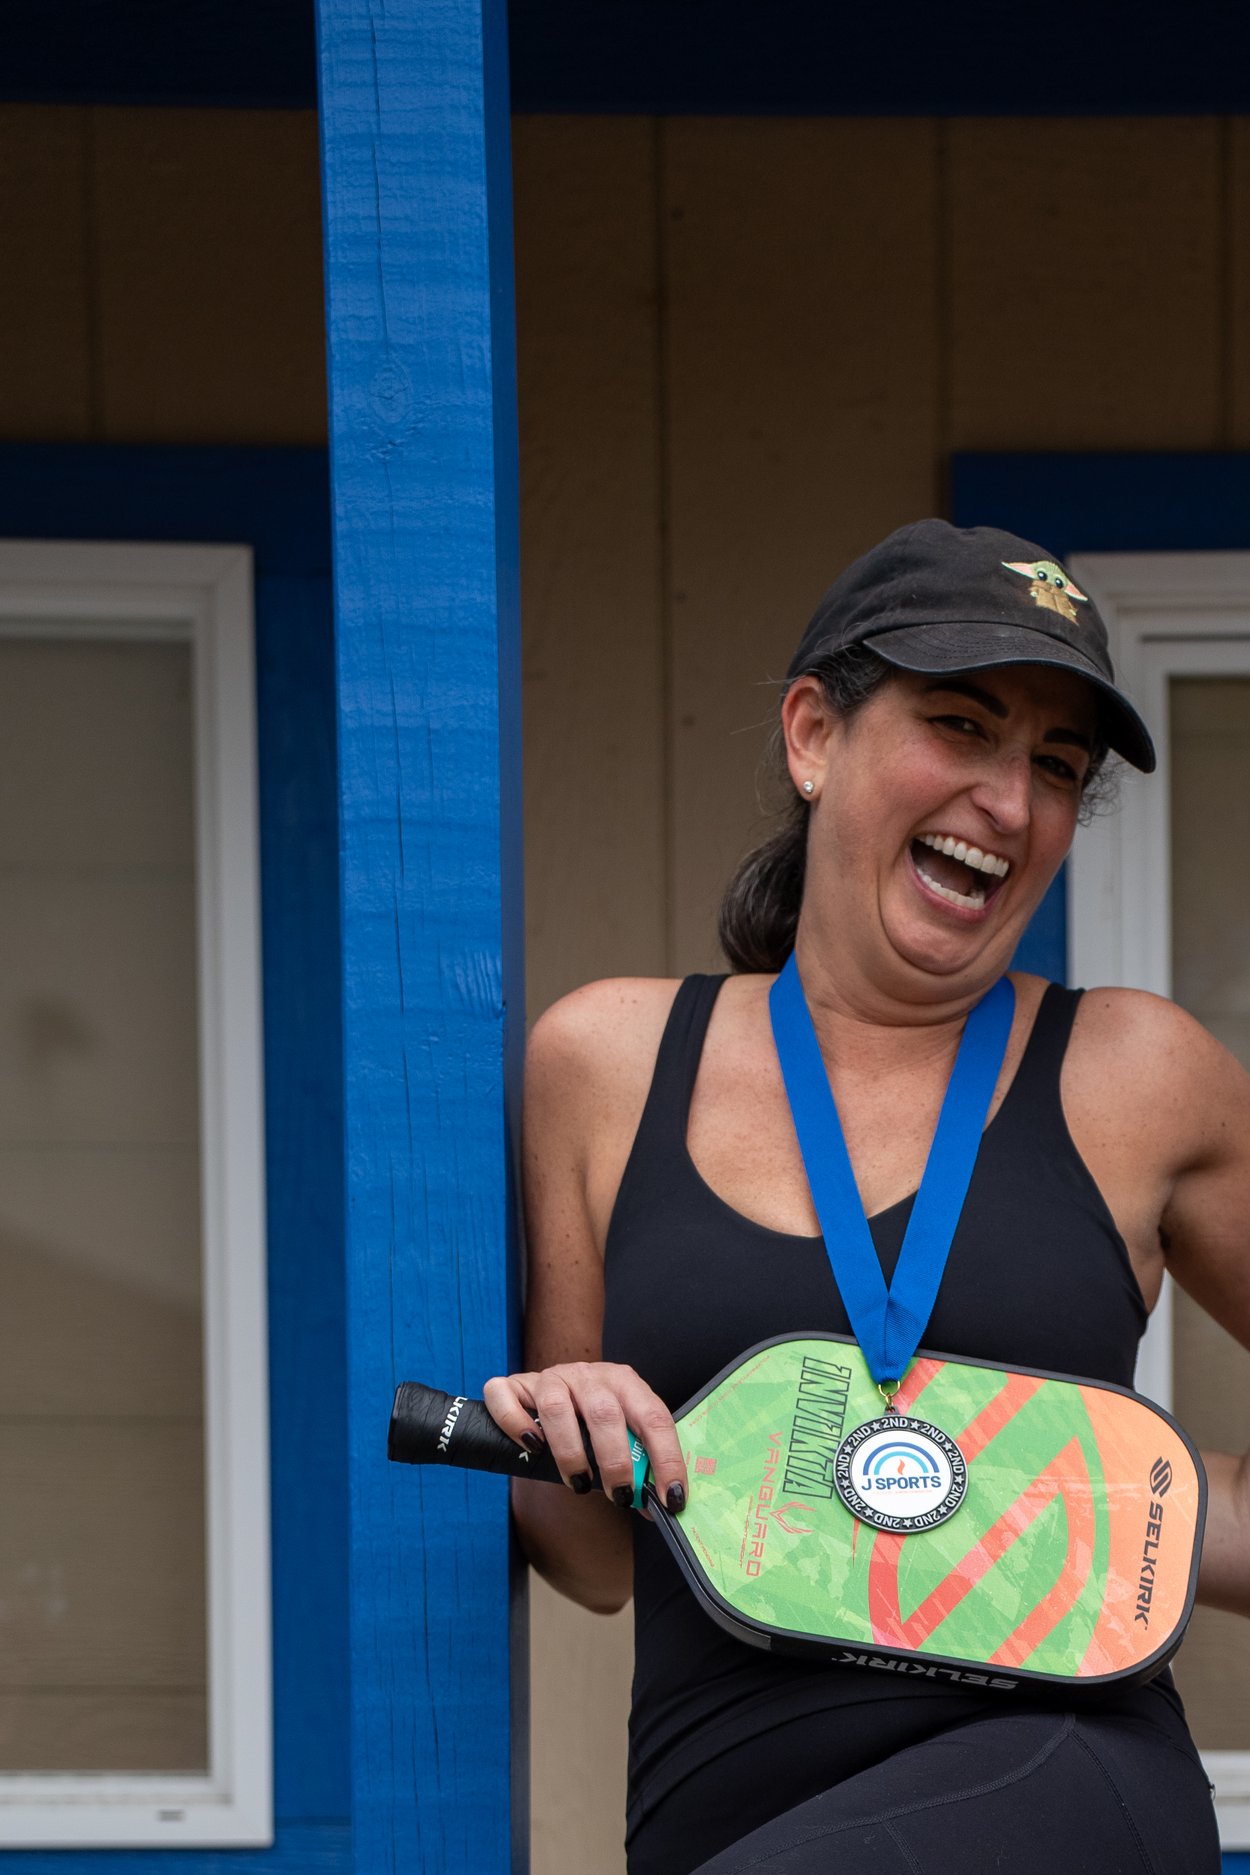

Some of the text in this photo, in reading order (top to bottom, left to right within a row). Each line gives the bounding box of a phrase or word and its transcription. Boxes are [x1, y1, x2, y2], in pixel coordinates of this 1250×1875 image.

[881, 1417, 908, 1428] 2ND
[920, 1424, 946, 1444] 2ND
[848, 1426, 871, 1445] 2ND
[837, 1454, 850, 1478] 2ND
[948, 1450, 964, 1473] 2ND
[861, 1475, 942, 1491] J SPORTS
[746, 1431, 783, 1577] VANGUARD
[844, 1487, 865, 1511] 2ND
[945, 1484, 963, 1508] 2ND
[874, 1512, 901, 1528] 2ND
[914, 1511, 941, 1527] 2ND
[1135, 1500, 1164, 1626] SELKIRK
[839, 1652, 1019, 1690] SELKIRK
